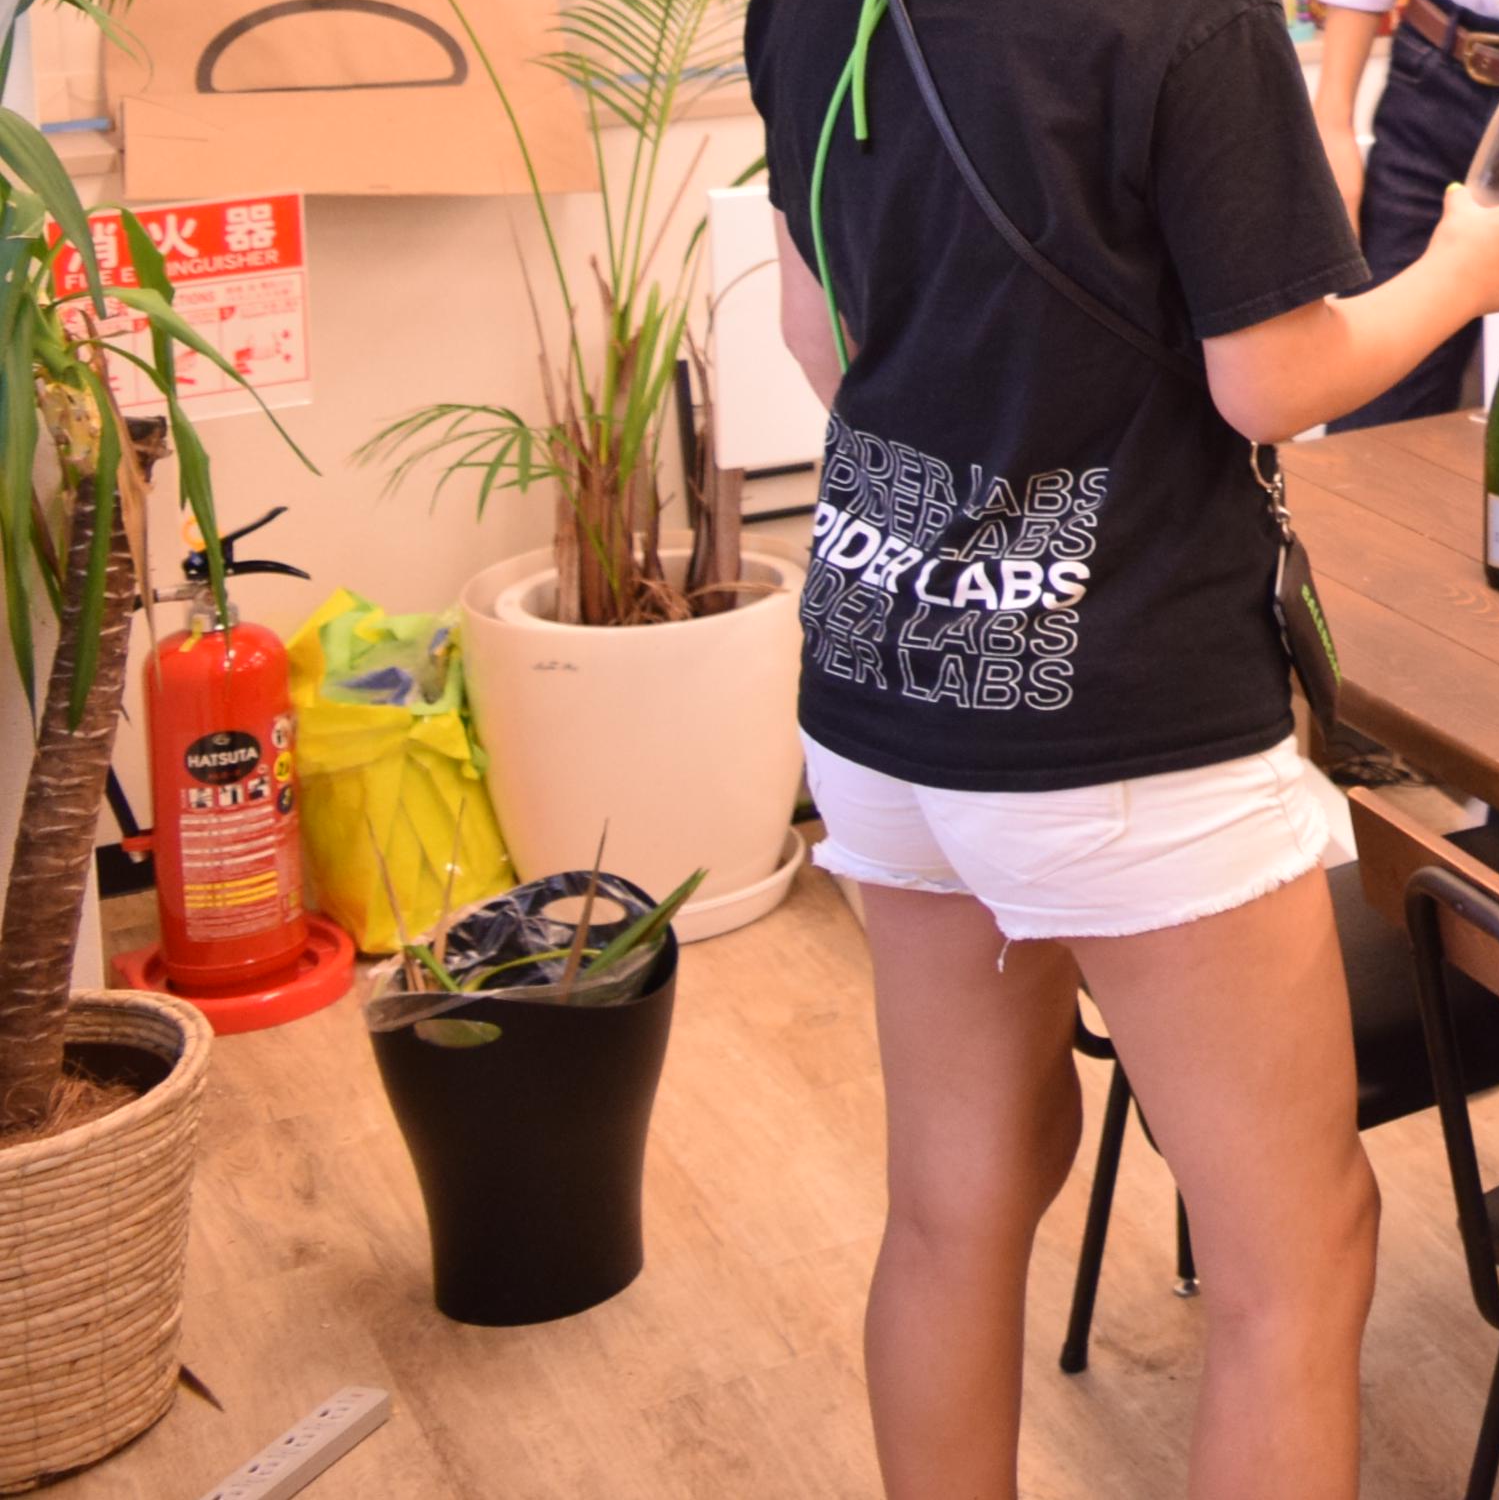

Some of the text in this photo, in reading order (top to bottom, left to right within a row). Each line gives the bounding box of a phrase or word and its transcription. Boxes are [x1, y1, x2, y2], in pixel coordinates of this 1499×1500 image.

[64, 249, 280, 291] FIE EINGUISHER
[821, 453, 953, 550] PIDER
[813, 501, 1091, 610] PIDER LABS
[898, 602, 1079, 658] LABS
[898, 648, 1074, 710] LABS
[187, 746, 259, 768] HATSUTA
